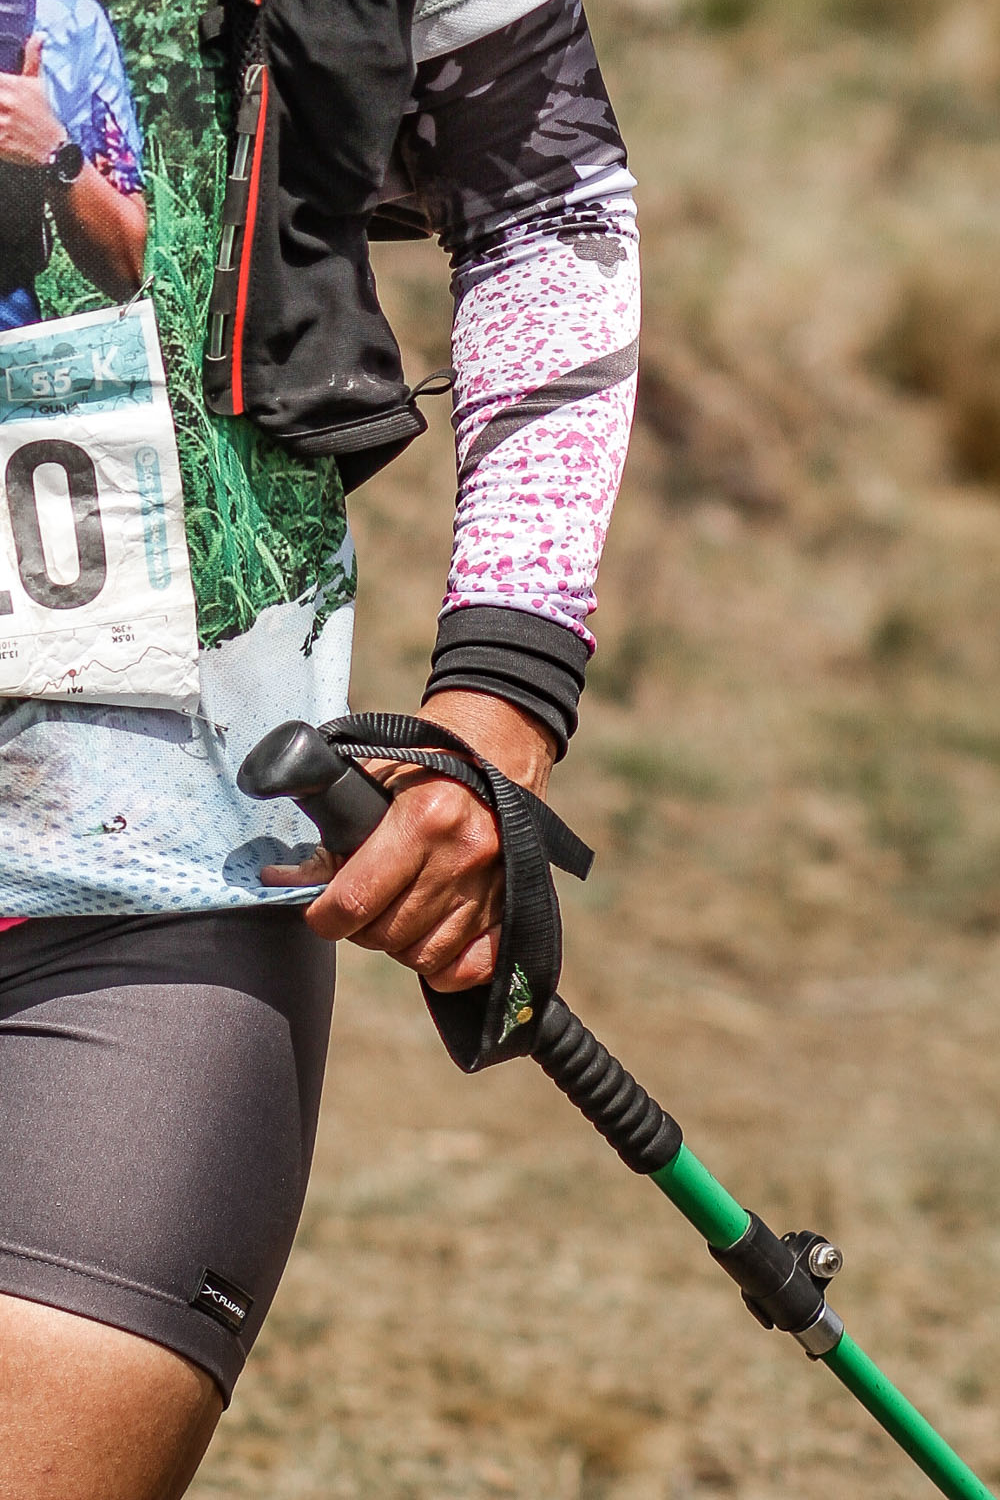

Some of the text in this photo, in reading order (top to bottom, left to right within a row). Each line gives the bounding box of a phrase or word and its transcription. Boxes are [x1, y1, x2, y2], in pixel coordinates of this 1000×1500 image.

[31, 343, 125, 396] 55 K
[111, 624, 132, 634] +390
[111, 634, 135, 644] 10.5K
[67, 685, 84, 695] PA1
